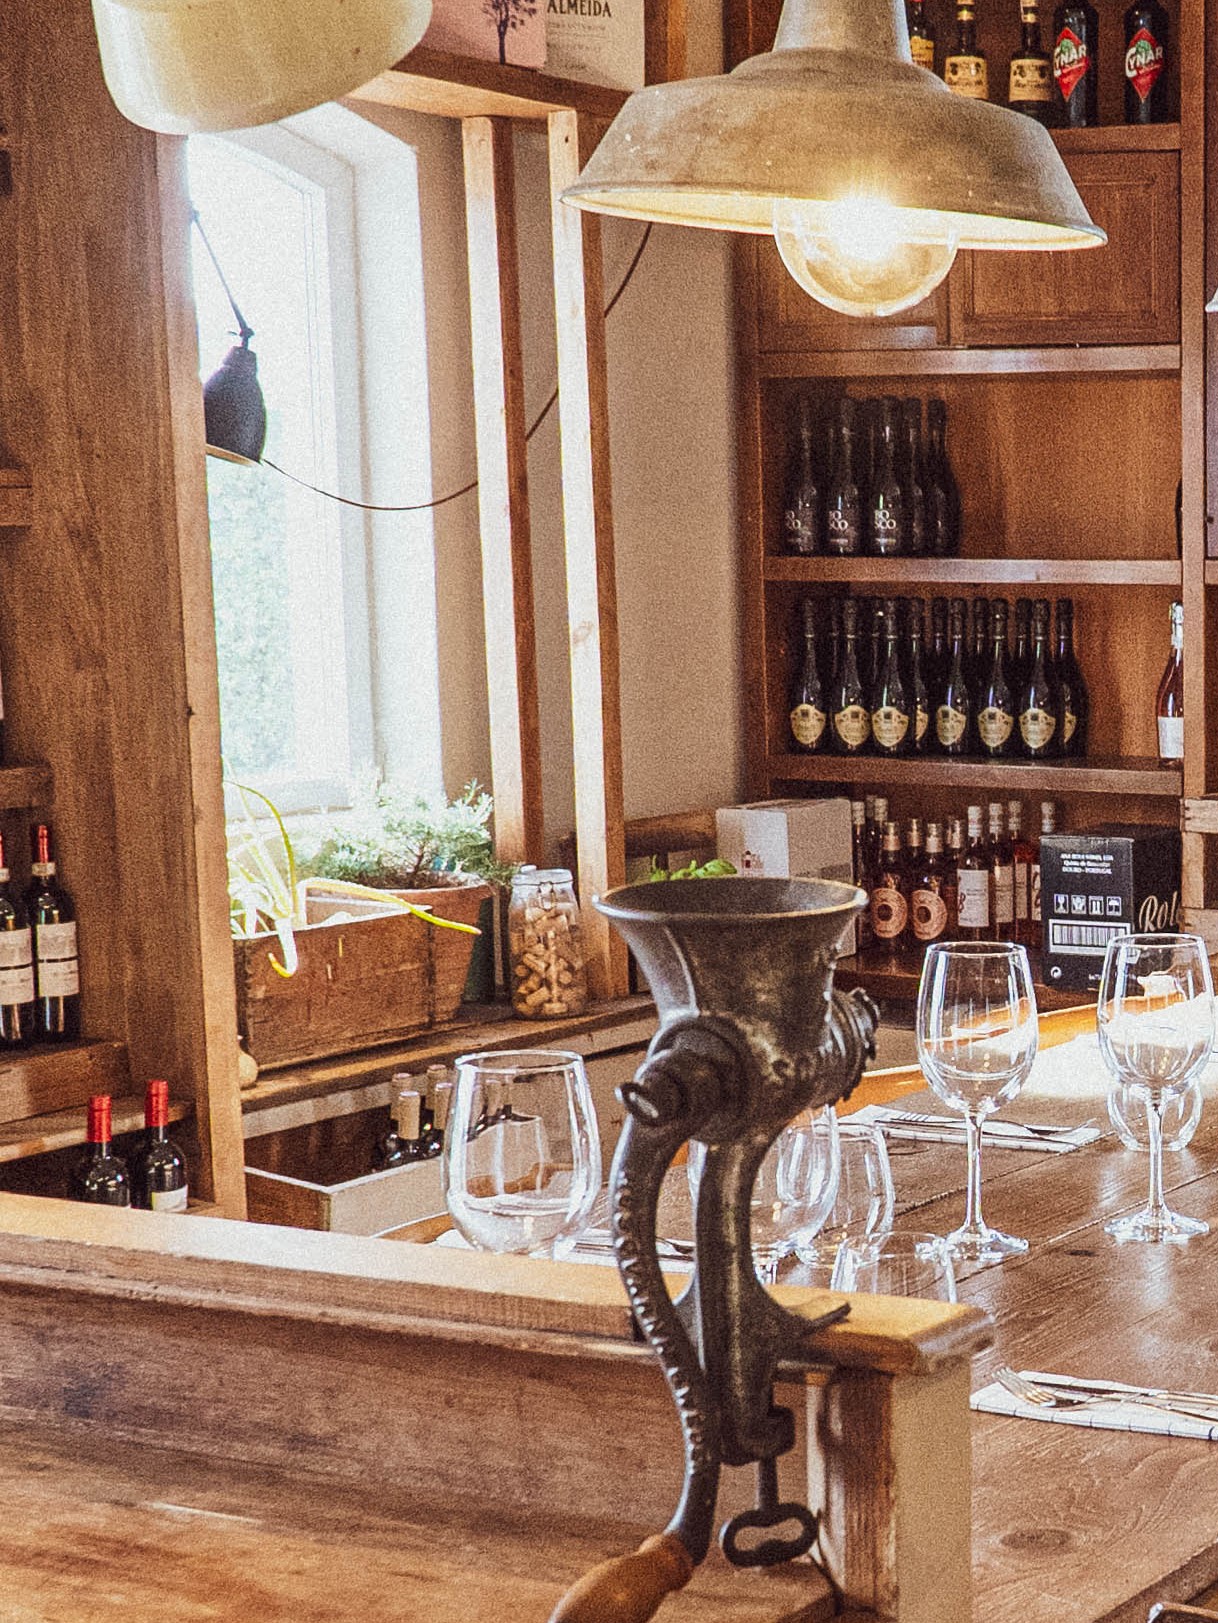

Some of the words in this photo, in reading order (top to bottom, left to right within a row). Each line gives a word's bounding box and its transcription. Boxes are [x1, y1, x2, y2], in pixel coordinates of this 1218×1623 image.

[547, 0, 612, 17] ALMEIDA
[1053, 44, 1087, 77] CYNAR
[1125, 45, 1163, 78] CYNAR
[1138, 890, 1181, 932] Rol
